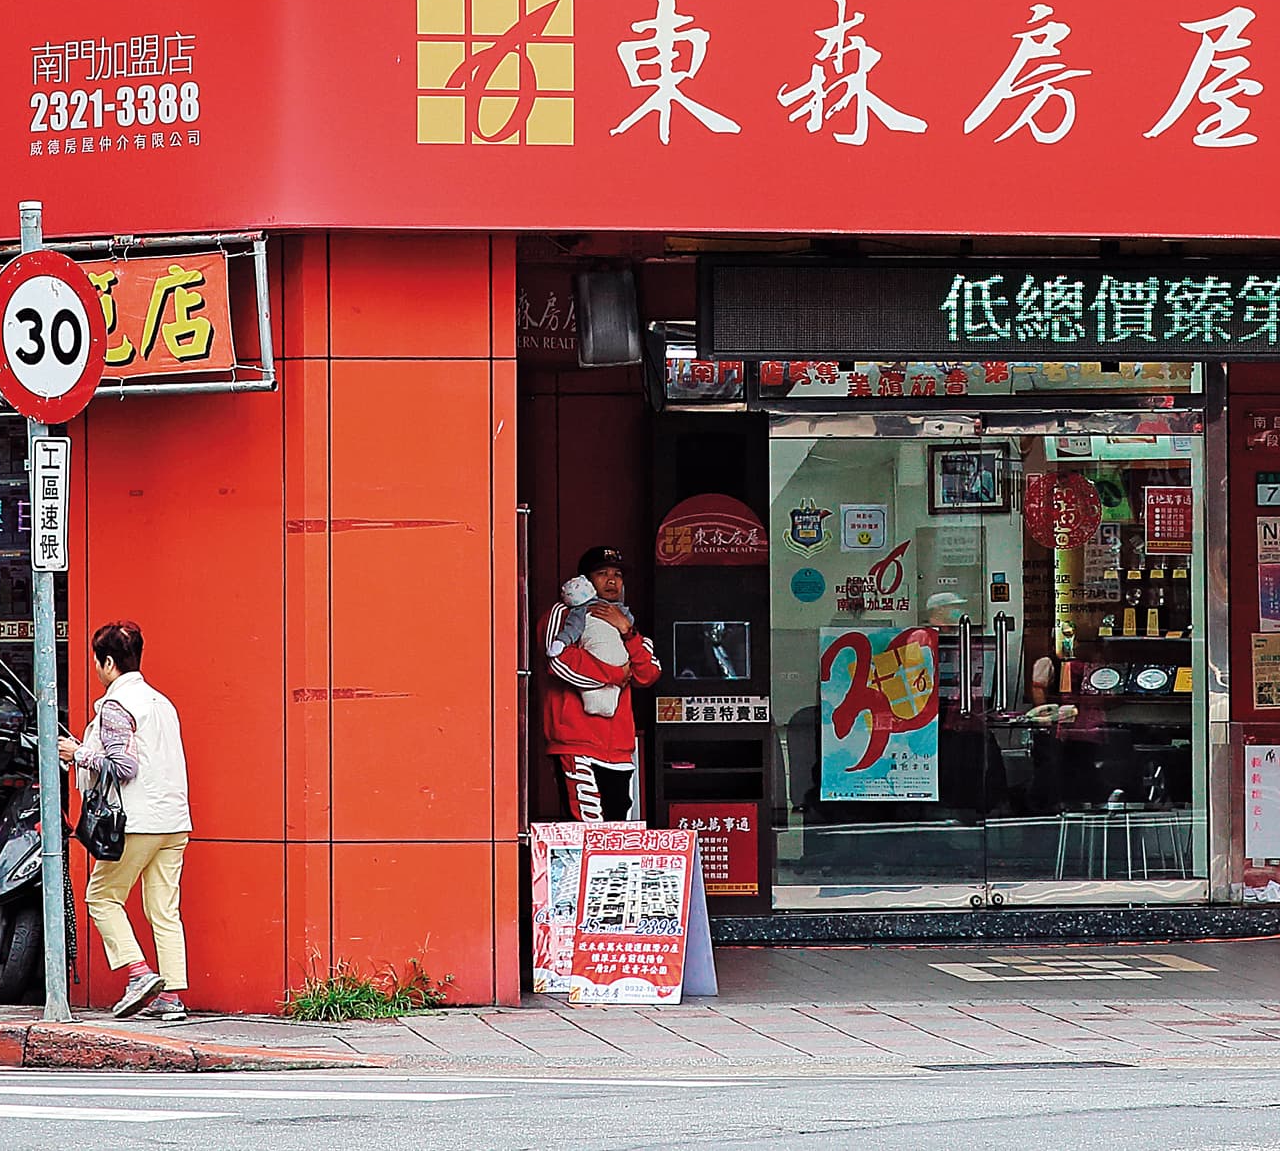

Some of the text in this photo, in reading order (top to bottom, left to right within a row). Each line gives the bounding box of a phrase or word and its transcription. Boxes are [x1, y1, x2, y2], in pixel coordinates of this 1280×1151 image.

[31, 31, 196, 85] 南門加盟店
[30, 81, 200, 132] 2321-3388
[30, 130, 200, 156] 威德房屋仲介有限公司
[15, 307, 83, 366] 30
[40, 448, 60, 560] 工區速限
[587, 831, 689, 851] 空南三村3房
